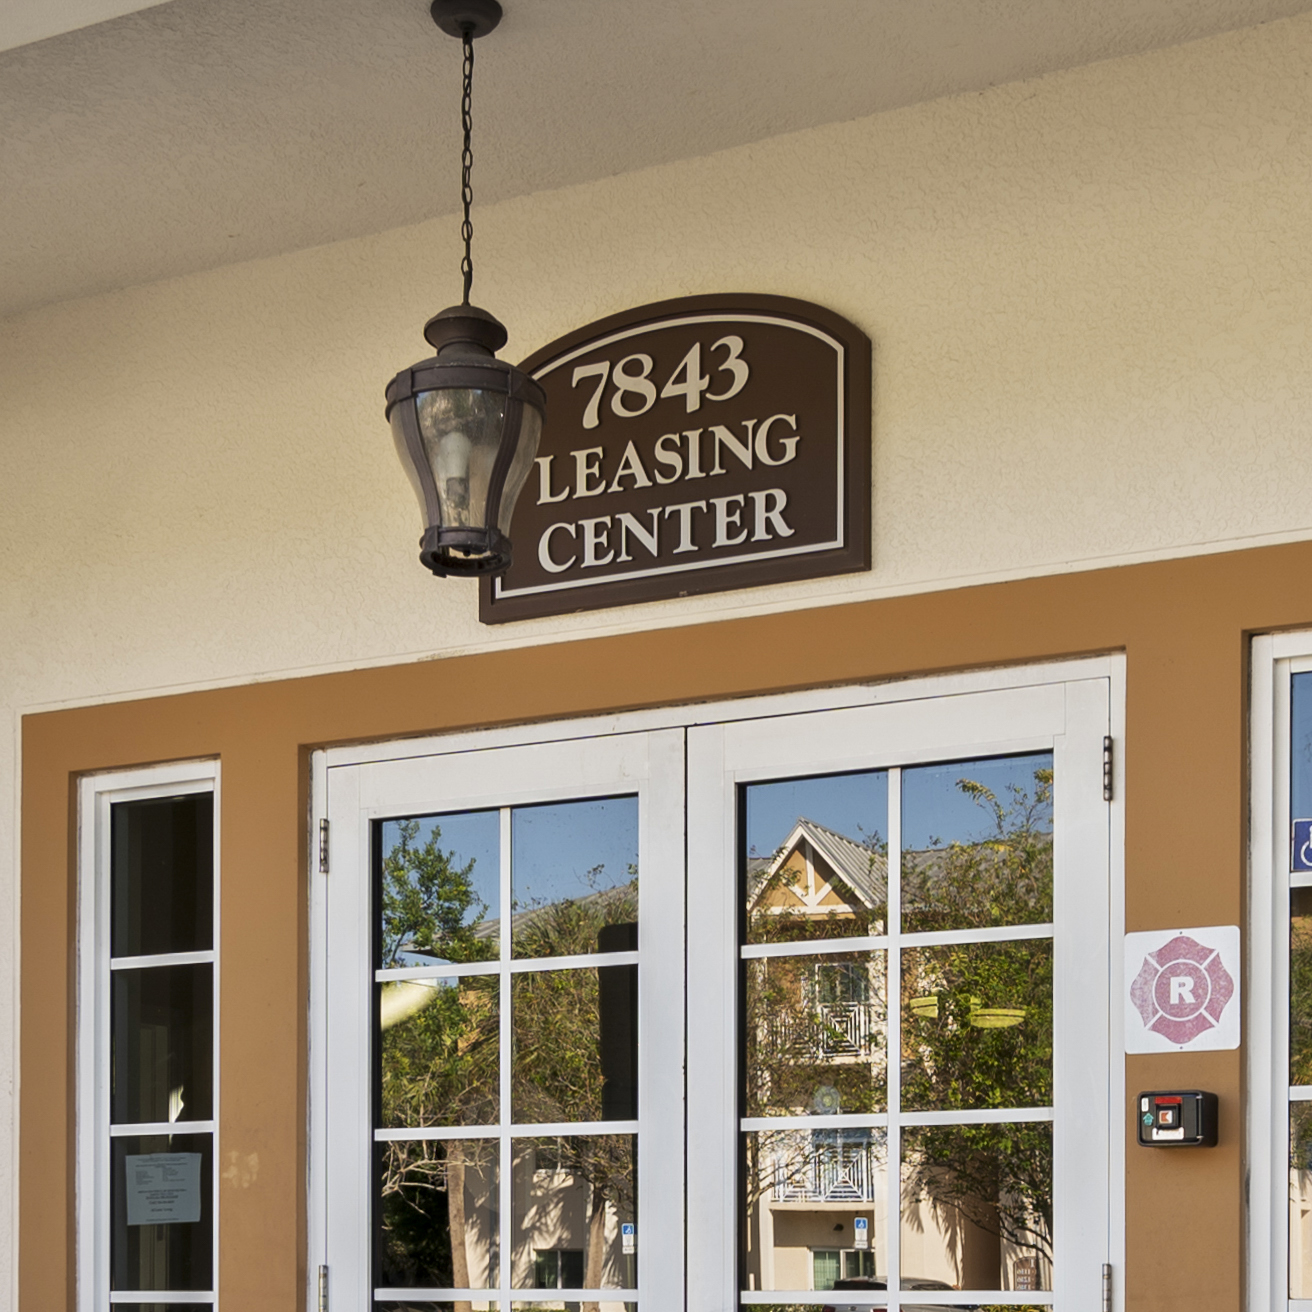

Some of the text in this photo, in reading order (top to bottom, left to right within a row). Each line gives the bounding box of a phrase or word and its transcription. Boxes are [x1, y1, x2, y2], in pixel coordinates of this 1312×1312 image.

[571, 334, 750, 430] 7843
[535, 413, 801, 506] LEASING
[537, 487, 795, 574] CENTER
[1170, 976, 1196, 1005] R
